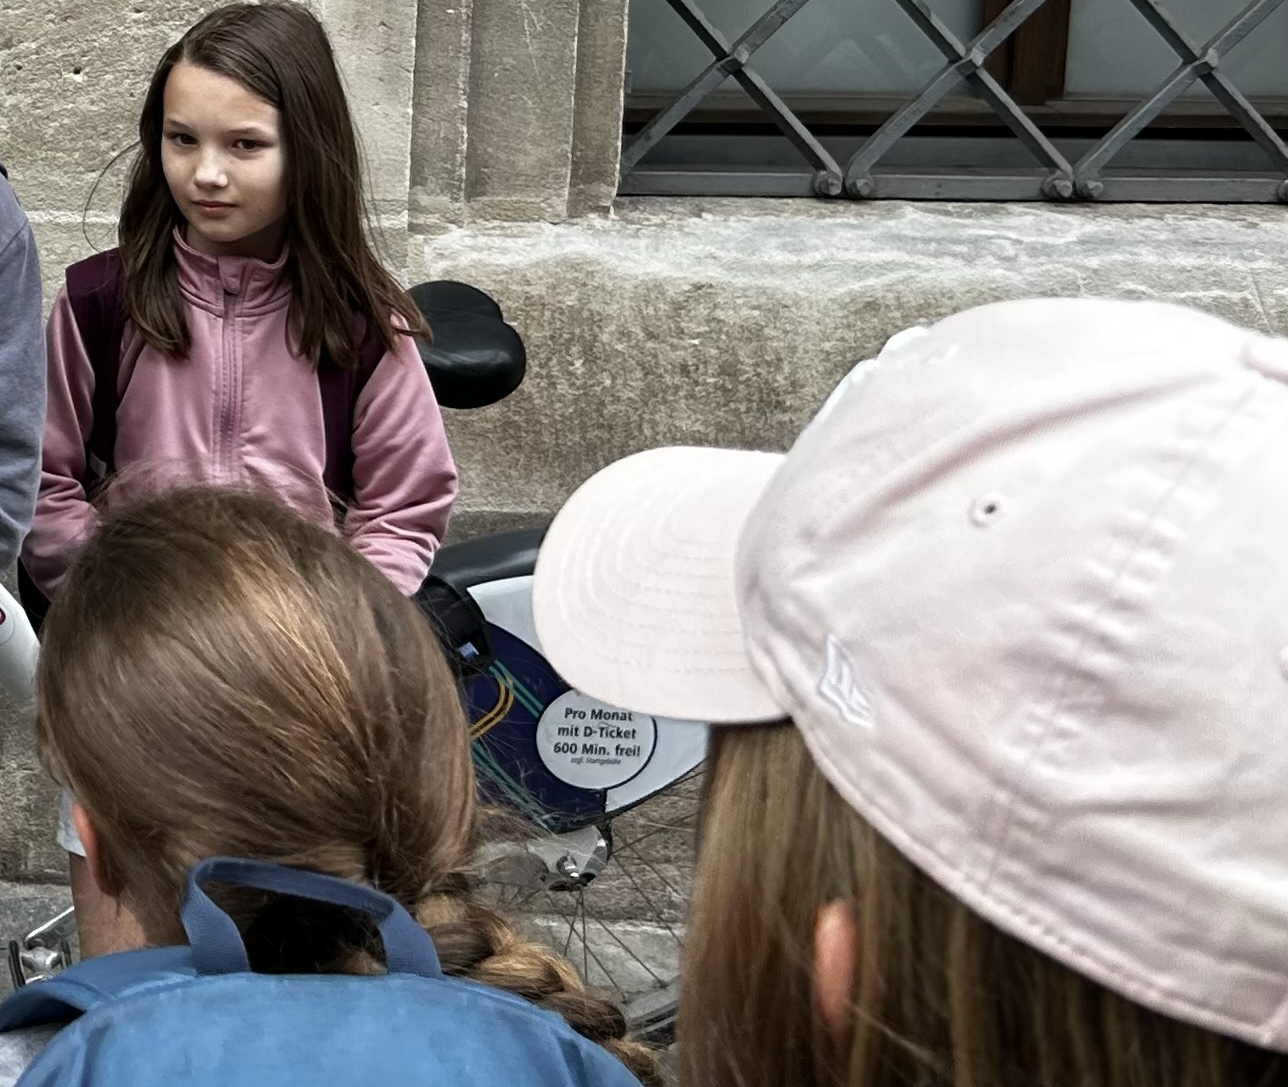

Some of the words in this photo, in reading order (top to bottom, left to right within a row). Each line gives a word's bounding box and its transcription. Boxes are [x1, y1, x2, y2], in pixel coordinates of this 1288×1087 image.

[564, 707, 586, 720] Pro
[590, 708, 633, 721] Monat
[557, 724, 579, 737] mit
[583, 725, 637, 740] D-Ticket
[553, 741, 578, 754] 600
[582, 743, 611, 756] Min.
[615, 743, 641, 757] frei!
